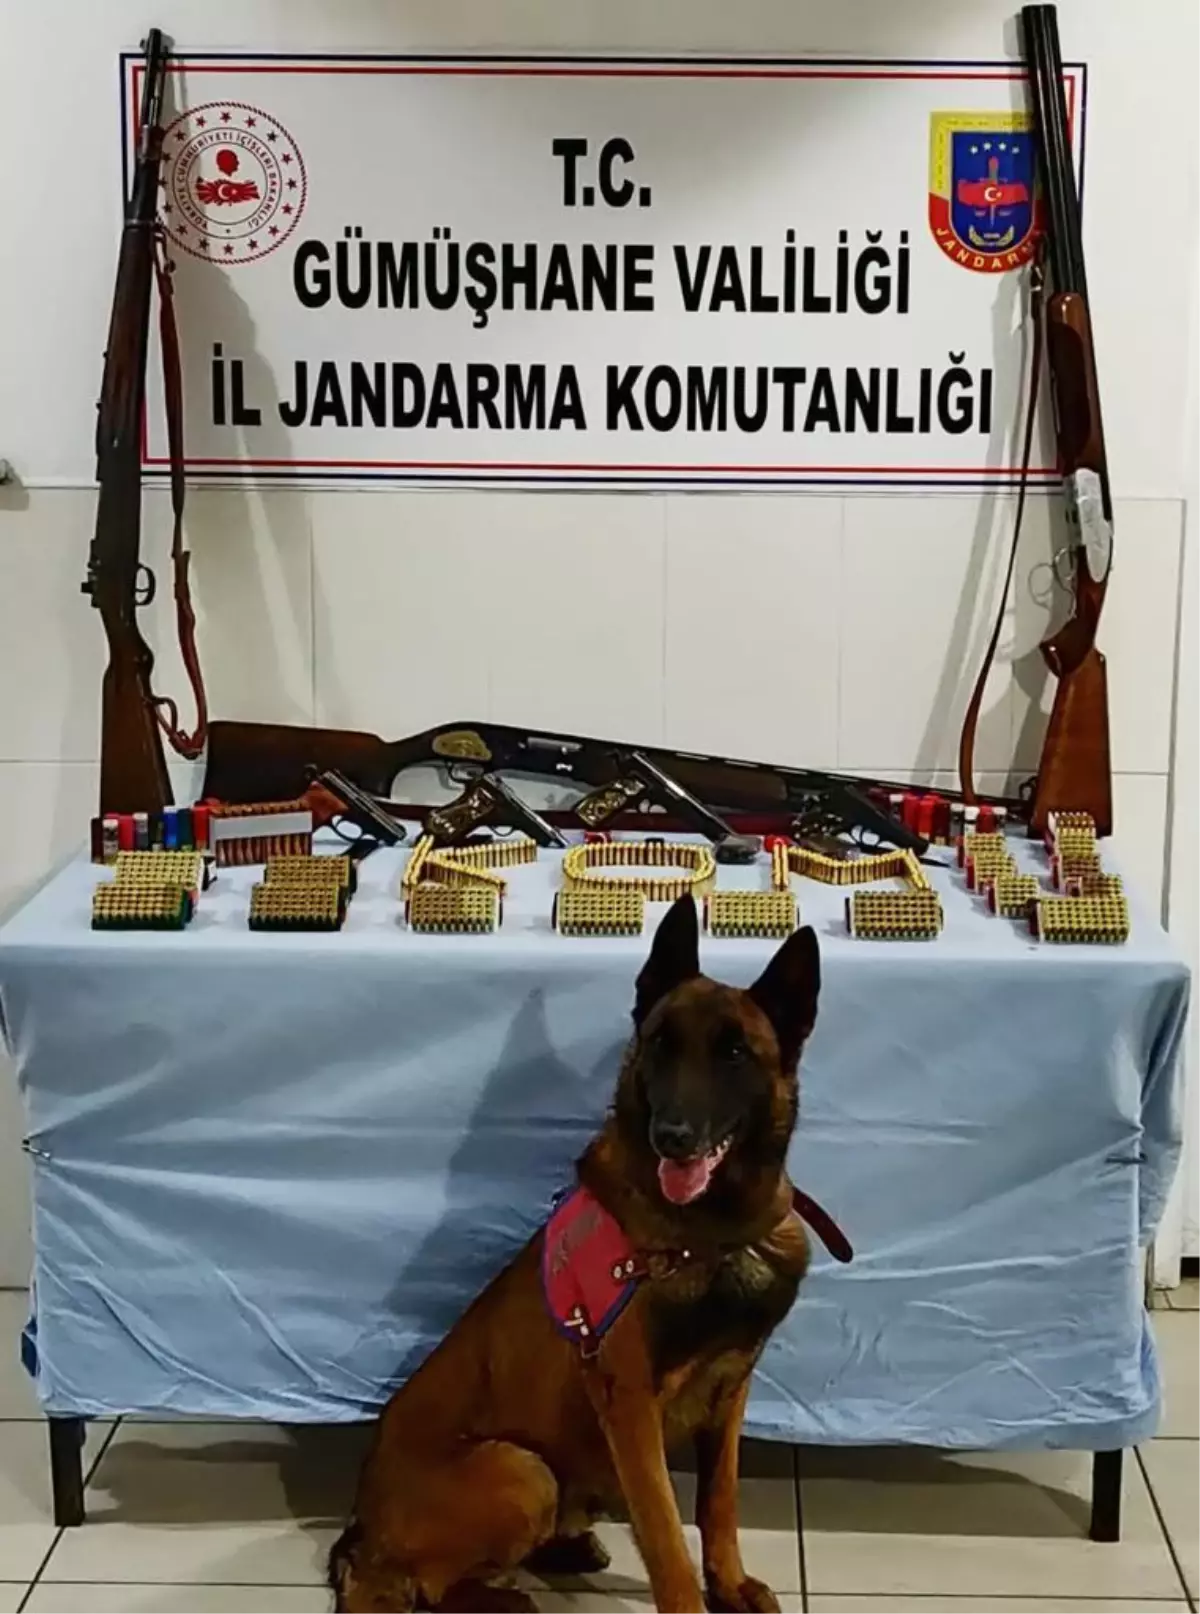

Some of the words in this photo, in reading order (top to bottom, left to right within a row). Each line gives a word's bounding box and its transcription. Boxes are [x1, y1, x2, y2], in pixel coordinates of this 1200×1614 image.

[552, 138, 651, 207] T.C.
[293, 226, 654, 328] GÜMÜŞHANE
[673, 228, 910, 314] VALİLİĞİ
[211, 342, 261, 427] İL
[278, 360, 587, 431] JANDARMA
[606, 351, 992, 434] KOMUTANLIĞI
